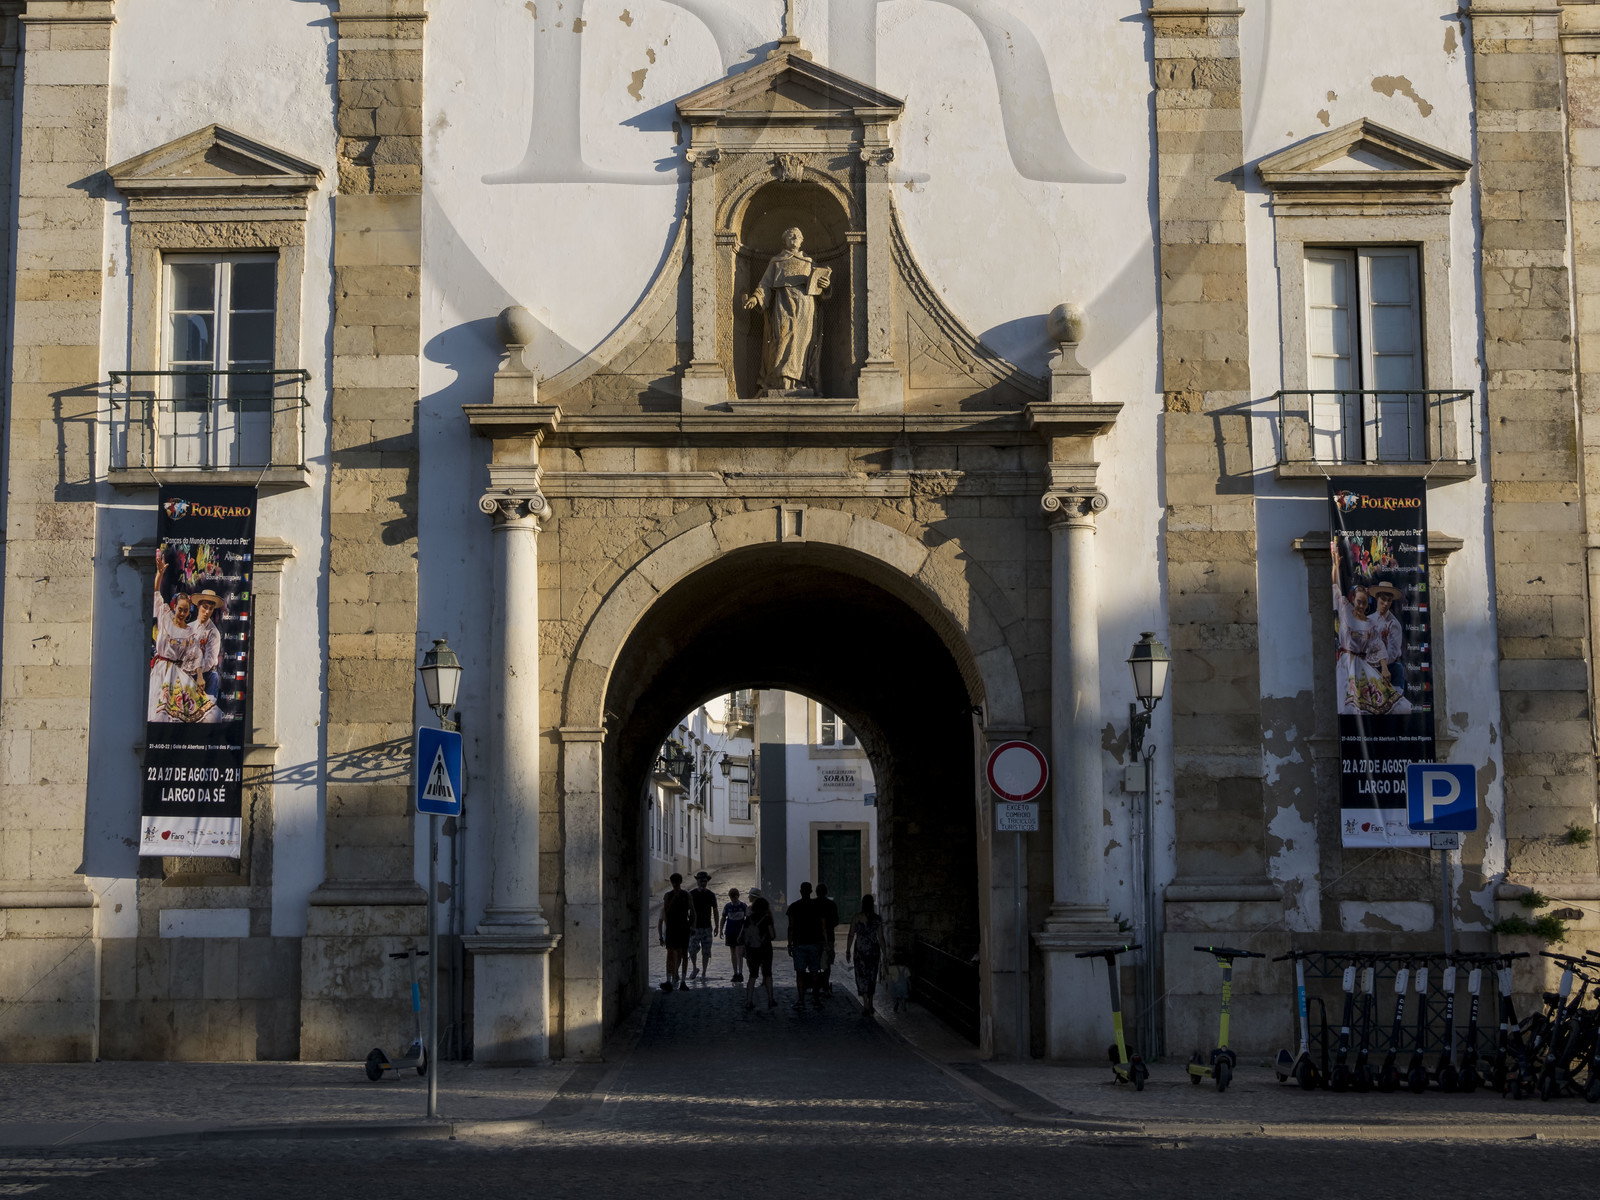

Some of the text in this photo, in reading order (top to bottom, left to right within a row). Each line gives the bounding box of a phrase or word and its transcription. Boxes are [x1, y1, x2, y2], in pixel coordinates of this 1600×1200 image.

[1343, 759, 1412, 773] 22 A 27 DE AGOST
[147, 767, 157, 781] 22
[157, 768, 163, 781] A
[164, 767, 173, 781] 27
[174, 768, 186, 781] DE
[188, 768, 219, 782] AGOSTO
[224, 768, 234, 782] 22
[235, 768, 240, 782] H
[161, 786, 226, 802] LARGO DA SÉ
[1358, 780, 1406, 793] LARGO DA
[1422, 771, 1461, 824] P
[1396, 998, 1404, 1020] BIRD
